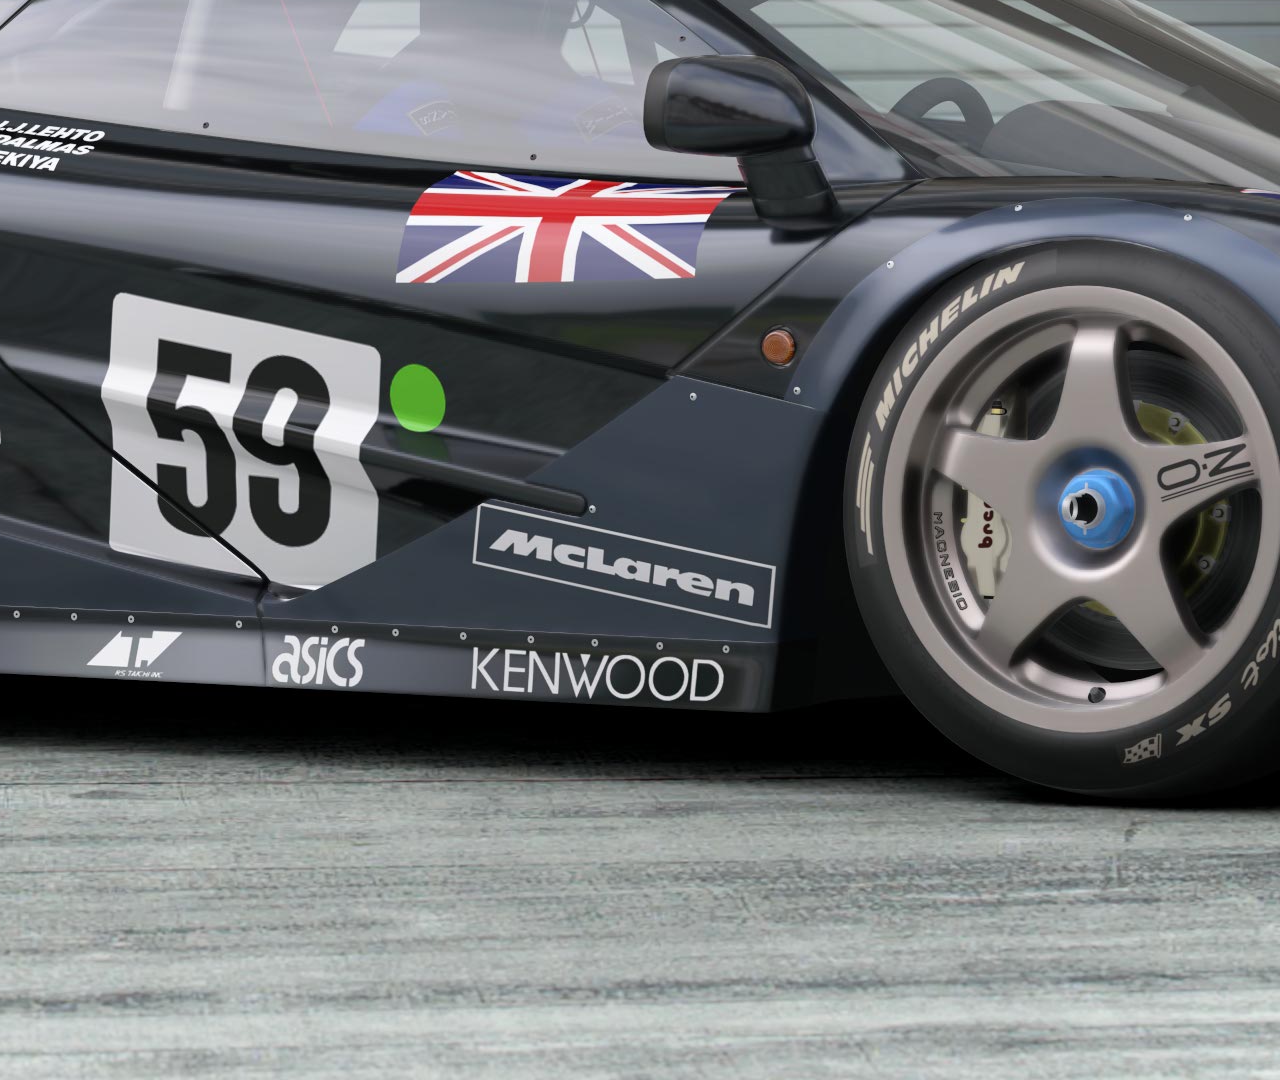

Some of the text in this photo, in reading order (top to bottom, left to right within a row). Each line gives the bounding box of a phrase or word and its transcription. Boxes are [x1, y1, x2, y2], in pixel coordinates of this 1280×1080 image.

[875, 261, 1026, 432] MICHELIN
[146, 339, 332, 547] 59
[489, 529, 755, 606] McLaren
[272, 635, 365, 687] asics
[470, 646, 725, 702] KENWOOD
[1176, 692, 1232, 747] SX
